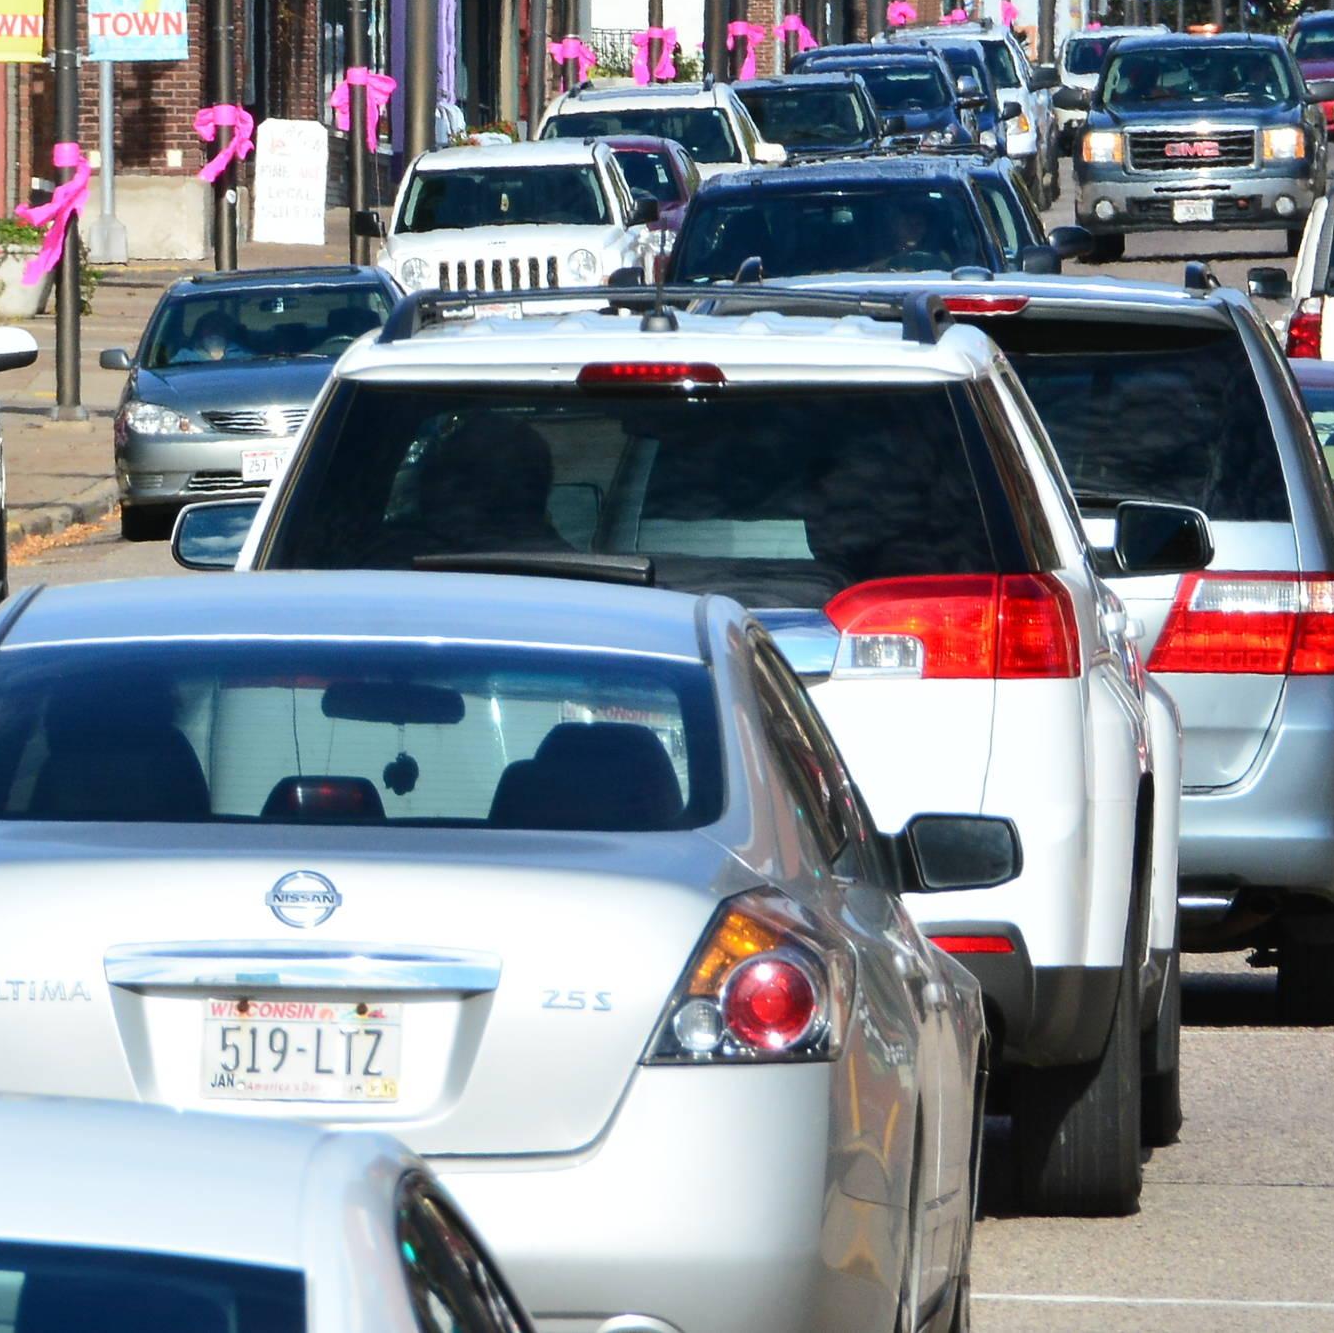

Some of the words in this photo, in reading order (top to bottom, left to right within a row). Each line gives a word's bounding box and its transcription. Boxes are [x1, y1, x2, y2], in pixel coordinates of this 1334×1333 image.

[92, 12, 183, 36] TOWN
[1165, 141, 1220, 157] GMC
[273, 893, 334, 904] NISSAN
[210, 1002, 317, 1019] WISCONSIN
[220, 1027, 384, 1076] 519-LTZ
[210, 1073, 235, 1088] JAN
